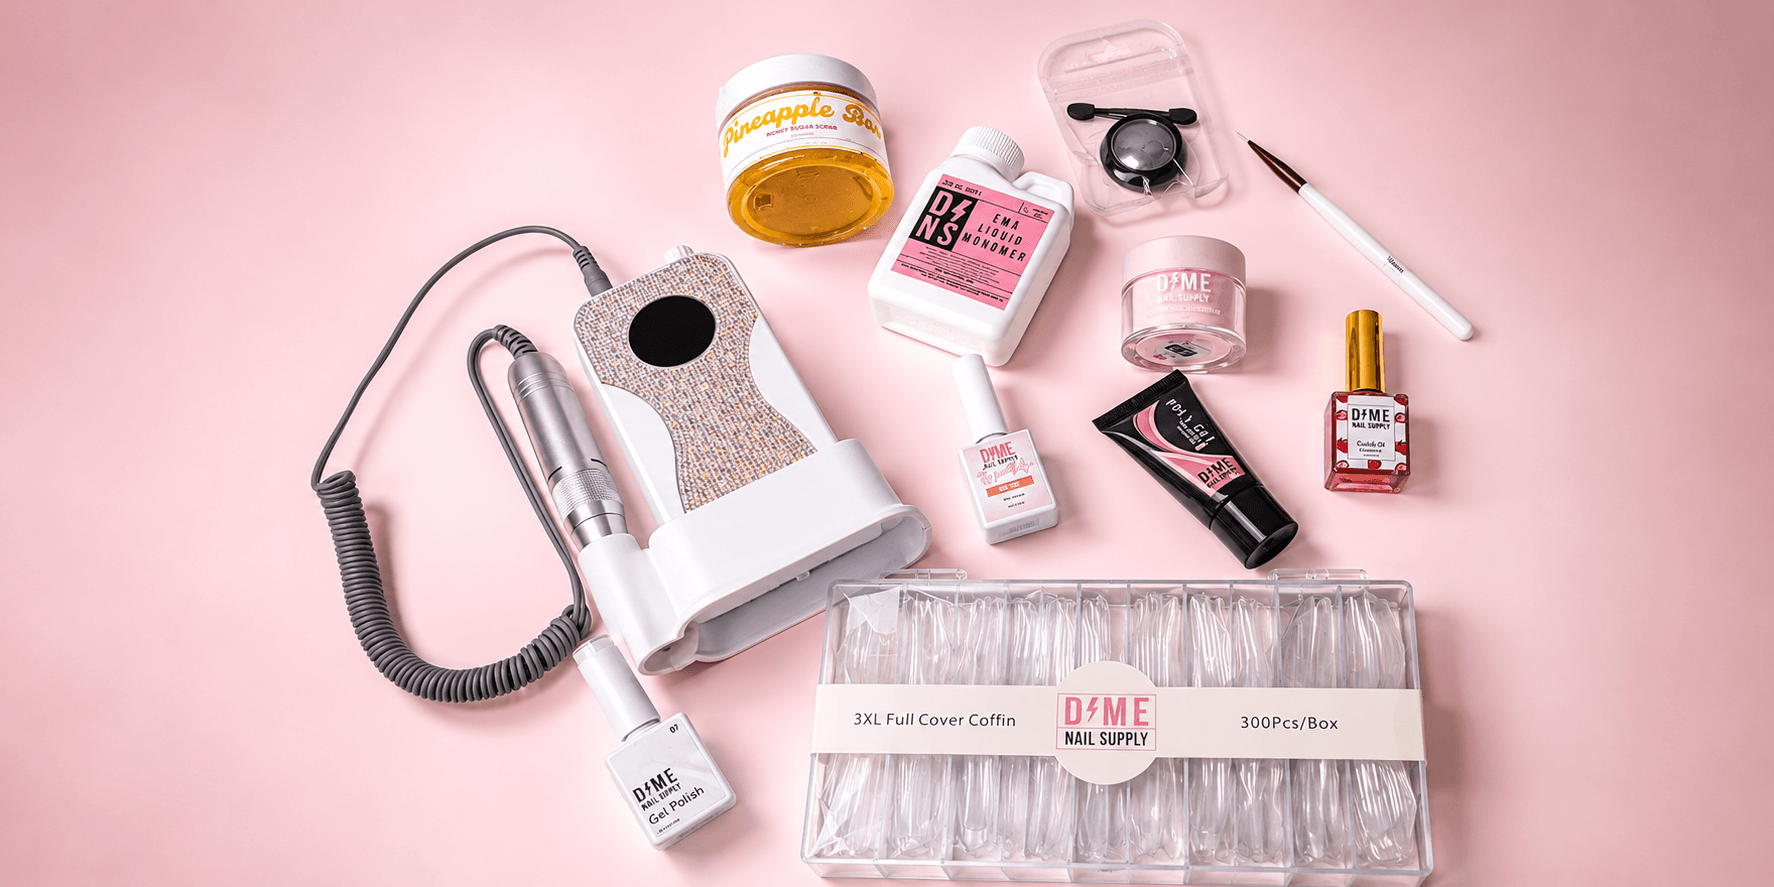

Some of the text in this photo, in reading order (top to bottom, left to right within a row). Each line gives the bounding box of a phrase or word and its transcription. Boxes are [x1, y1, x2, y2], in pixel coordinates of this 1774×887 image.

[723, 96, 835, 158] Pineapple
[992, 213, 1019, 230] EMA
[962, 232, 1026, 262] MONOMER
[853, 712, 1017, 727] 3XL Full Cover Coffin
[1240, 715, 1339, 731] 300Pcs/Box
[669, 723, 679, 734] 07
[1065, 731, 1149, 747] NAIL SUPPLY
[648, 807, 670, 825] Gel
[669, 787, 705, 812] Polish
